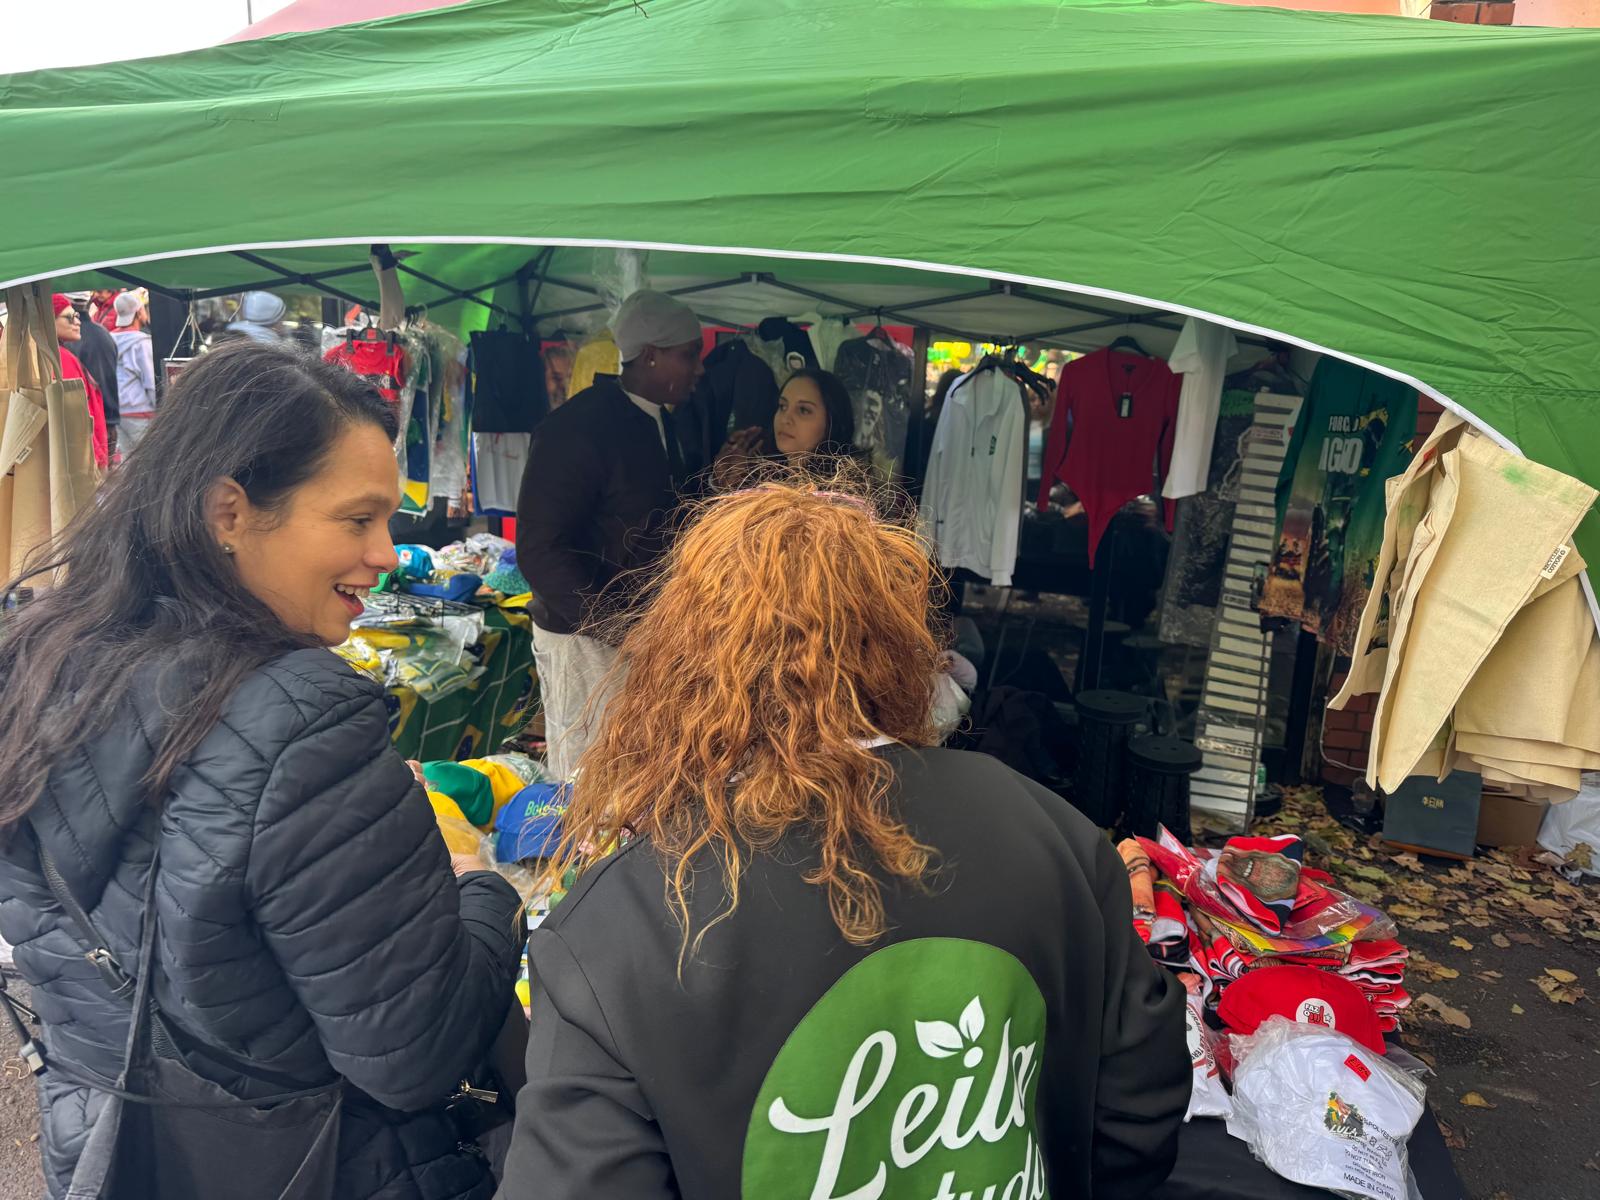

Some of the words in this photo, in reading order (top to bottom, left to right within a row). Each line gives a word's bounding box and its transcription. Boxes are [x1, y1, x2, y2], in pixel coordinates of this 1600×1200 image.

[1548, 555, 1562, 573] COTTON
[1304, 1003, 1320, 1014] FAZ
[1330, 1124, 1357, 1137] LULA
[1351, 1154, 1362, 1162] NOT
[1372, 1170, 1386, 1180] IRON
[1344, 1173, 1366, 1188] MADE
[1367, 1183, 1376, 1193] IN
